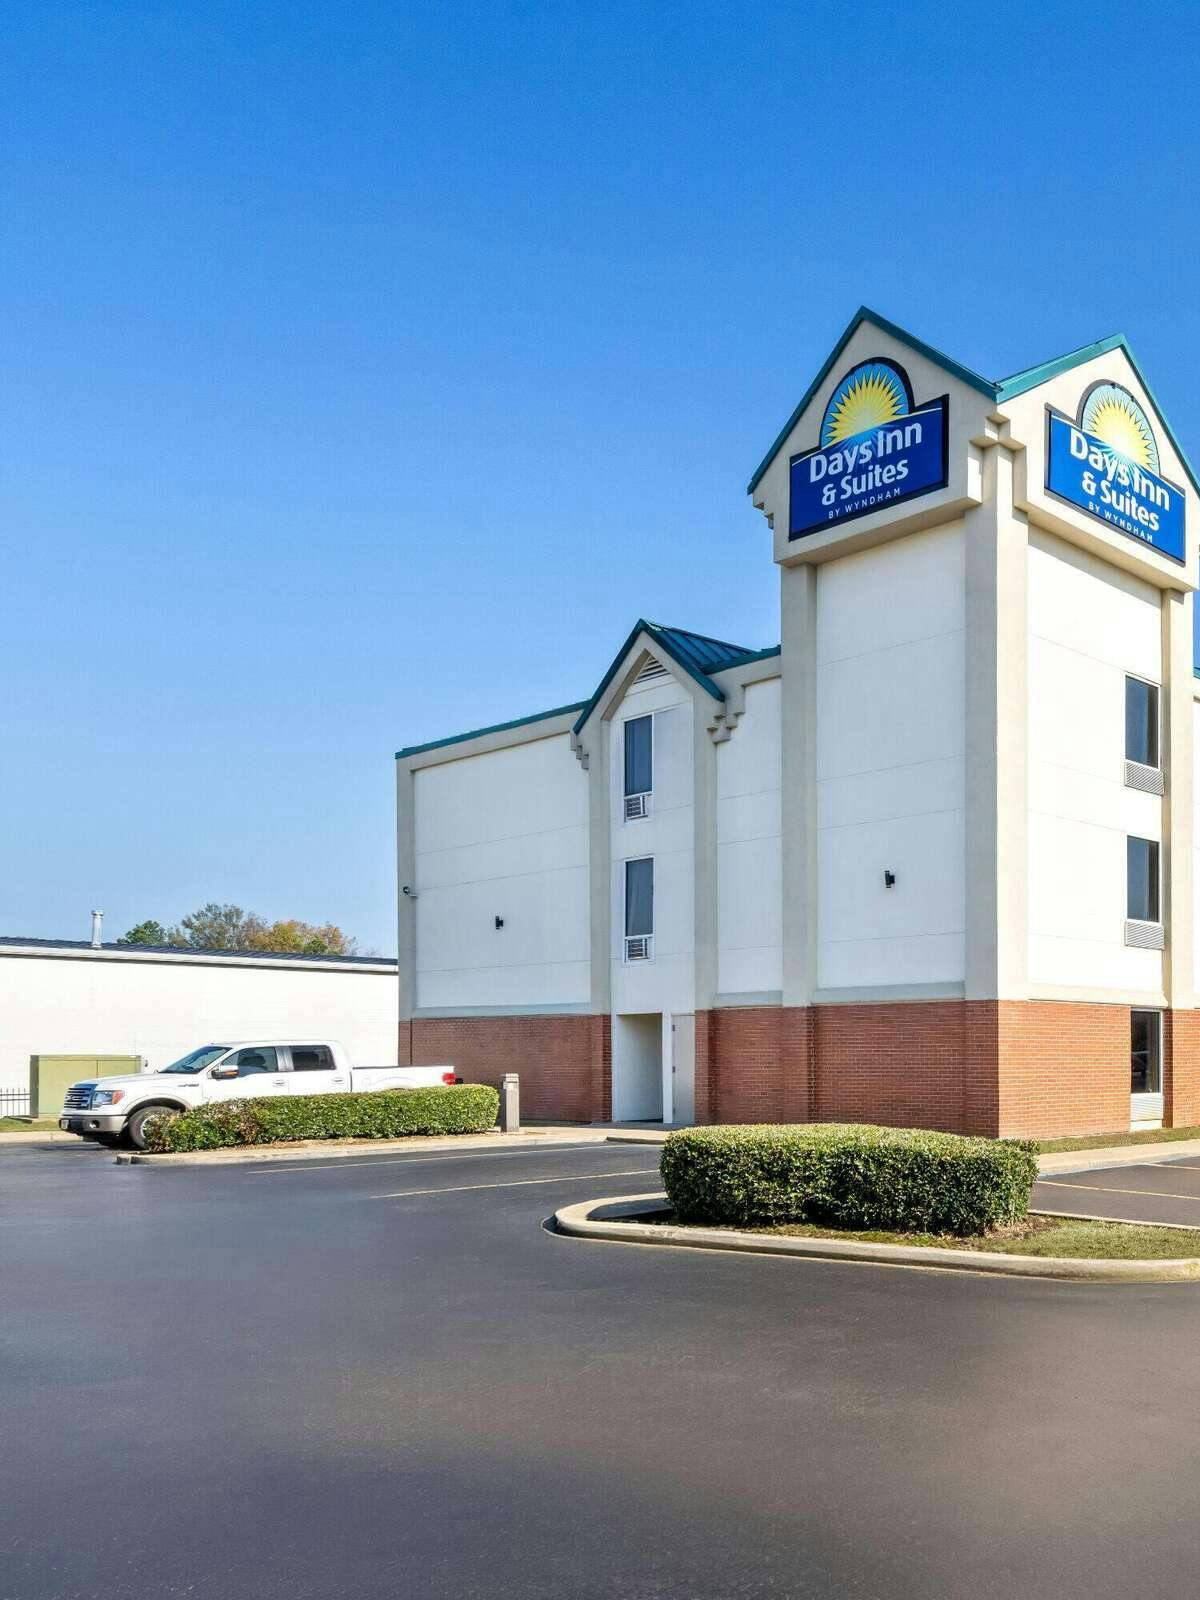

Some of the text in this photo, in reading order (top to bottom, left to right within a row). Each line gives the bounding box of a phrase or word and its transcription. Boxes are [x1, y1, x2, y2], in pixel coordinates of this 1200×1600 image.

[810, 422, 922, 483] Days Inn
[1070, 429, 1170, 511] Days Inn
[821, 459, 909, 506] & Suites
[828, 487, 901, 519] BY WYNDHAM
[1082, 471, 1160, 531] & Suites
[1088, 503, 1153, 543] BY WYNDHAM
